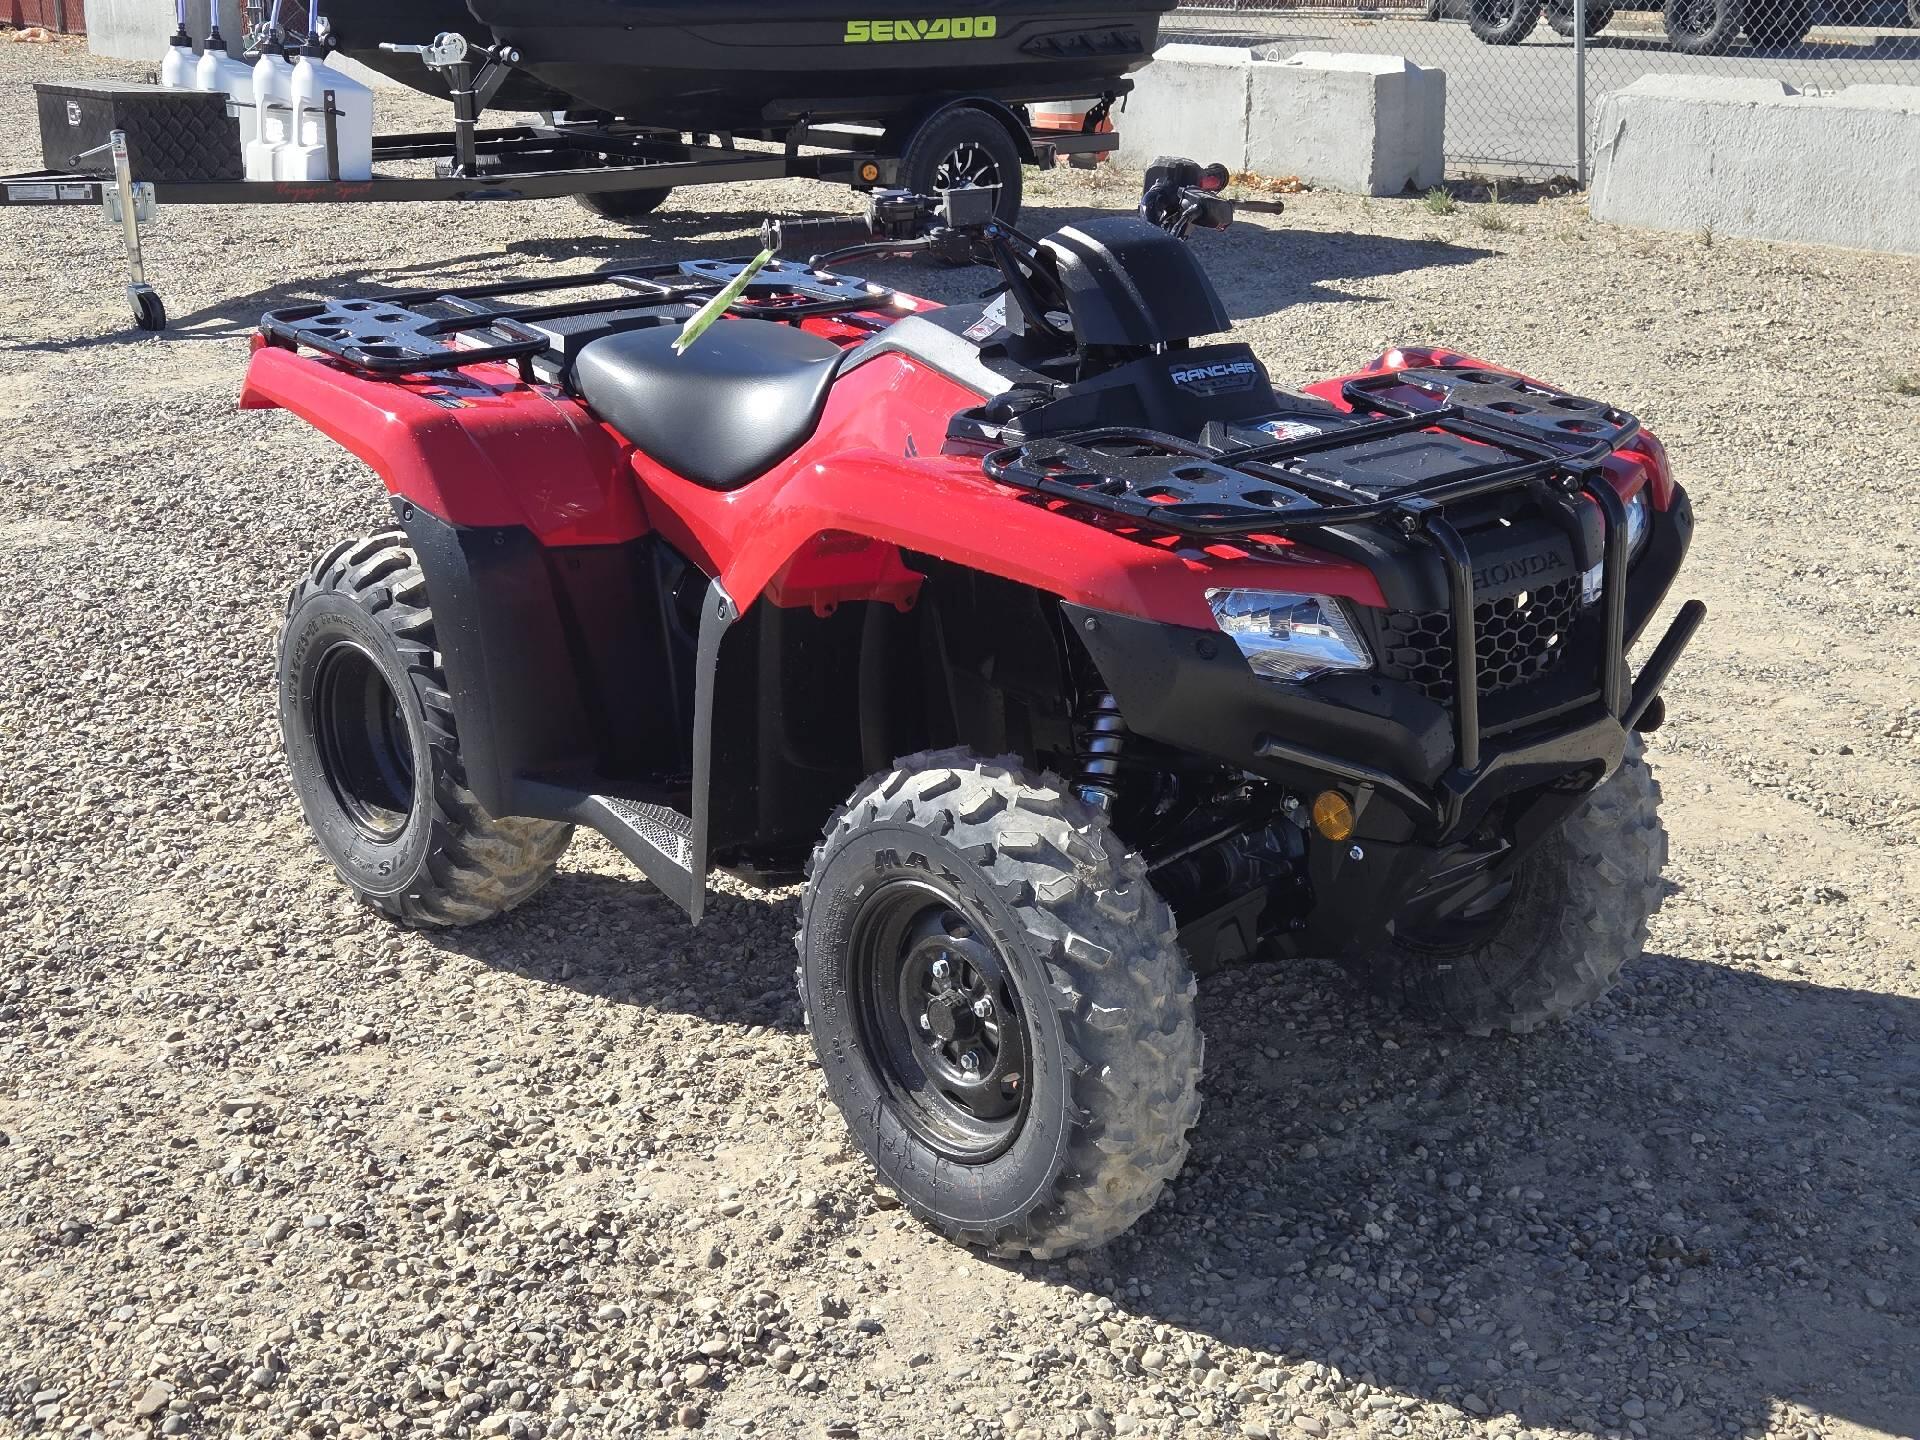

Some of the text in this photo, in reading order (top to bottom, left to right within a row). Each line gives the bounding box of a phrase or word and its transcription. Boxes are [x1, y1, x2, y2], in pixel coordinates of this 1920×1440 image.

[1171, 362, 1257, 385] RANCHER
[1472, 550, 1568, 591] HONDA
[875, 848, 1028, 981] MAXXIS
